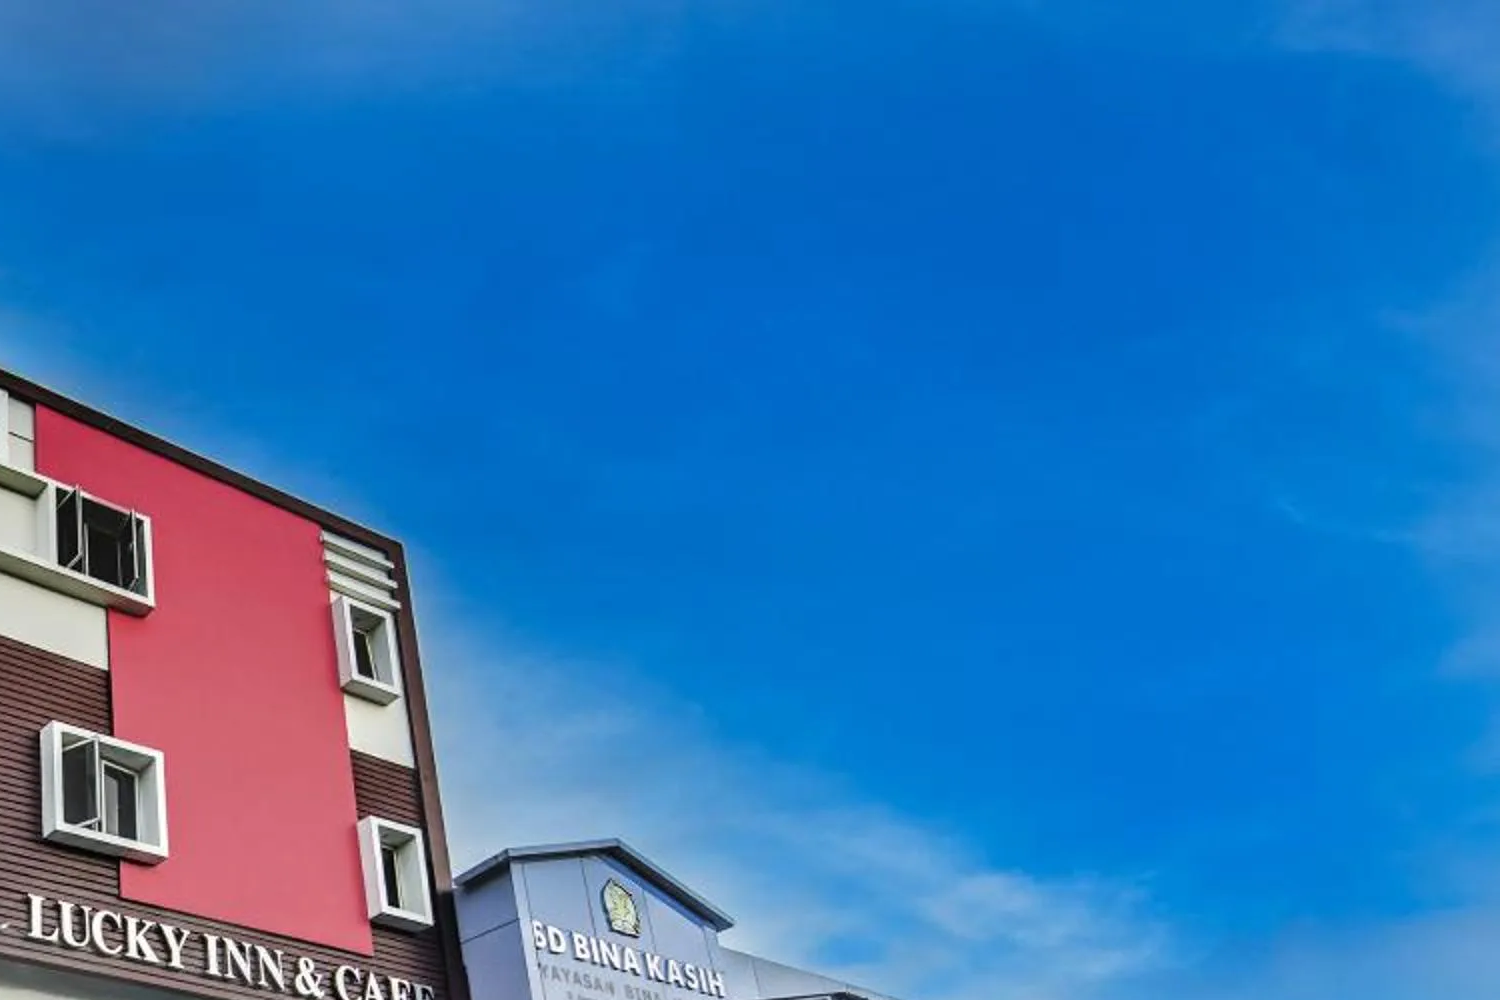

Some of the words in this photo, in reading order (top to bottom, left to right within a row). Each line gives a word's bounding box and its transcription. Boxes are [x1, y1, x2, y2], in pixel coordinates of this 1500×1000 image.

[27, 893, 190, 970] LUCKY
[203, 932, 285, 992] INN
[294, 957, 324, 1000] &
[531, 919, 566, 954] SD
[572, 931, 641, 976] BINA
[644, 952, 727, 998] KASIH
[540, 963, 615, 996] YAYASAN
